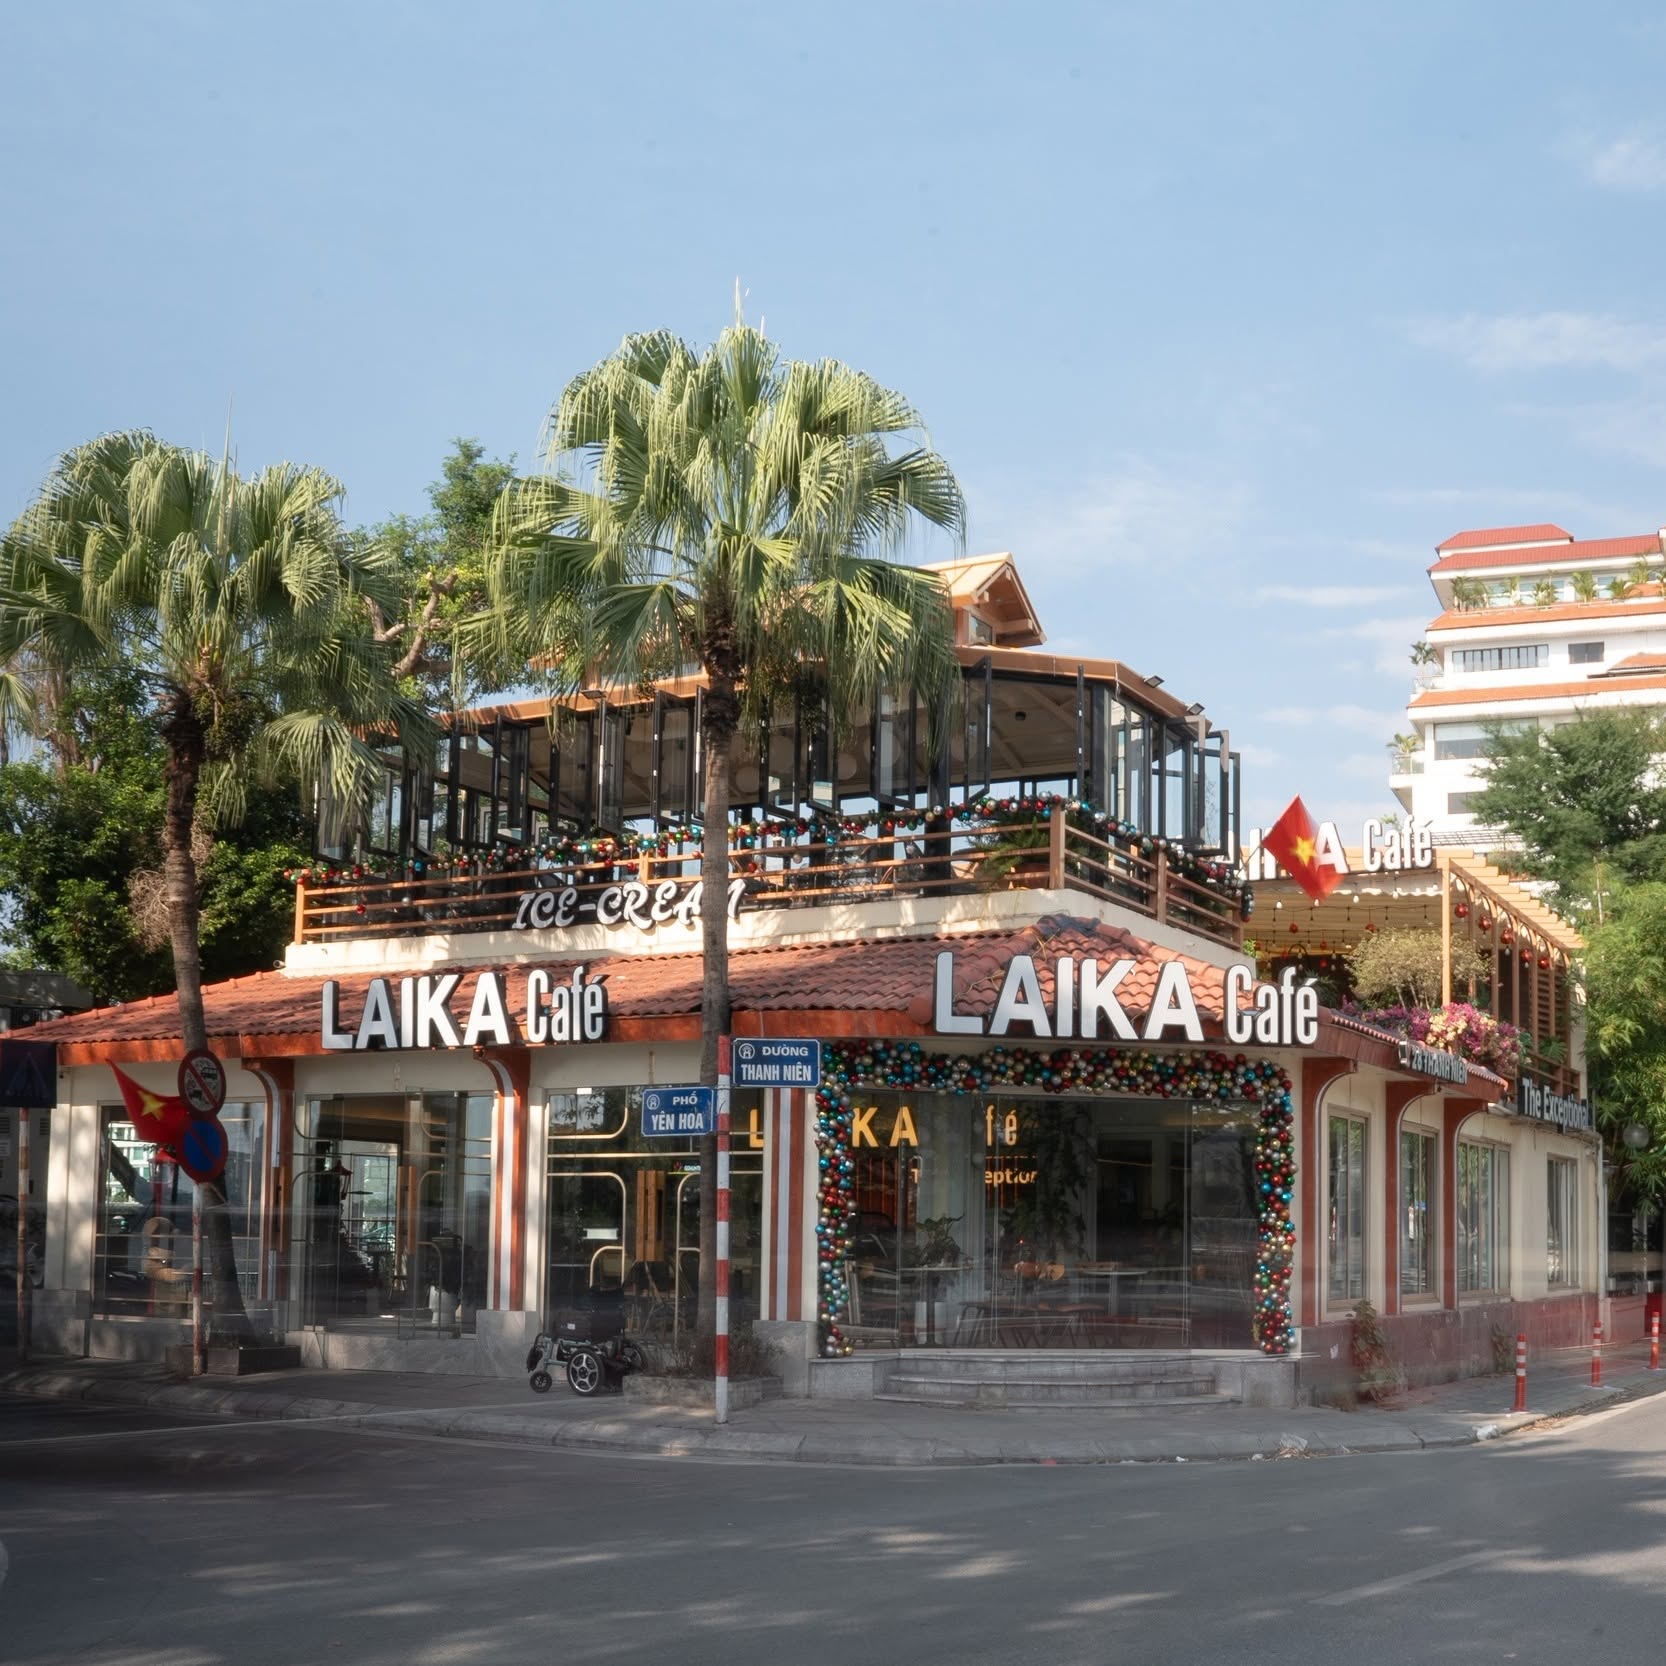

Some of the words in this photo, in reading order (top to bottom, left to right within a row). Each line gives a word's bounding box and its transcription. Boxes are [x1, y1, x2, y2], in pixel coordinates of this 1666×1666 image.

[1362, 813, 1434, 872] Café
[321, 971, 511, 1049] LAIKA
[527, 965, 609, 1043] Café
[936, 950, 1205, 1042] LAIKA
[1225, 963, 1319, 1046] Café
[762, 1043, 809, 1057] ĐƯỜNG
[741, 1063, 780, 1081] THANH
[783, 1061, 812, 1082] NIÊN
[672, 1090, 698, 1106] PHỐ
[1522, 1076, 1542, 1118] The
[1543, 1084, 1589, 1135] Exceptional
[651, 1110, 675, 1131] YÊN
[679, 1112, 704, 1130] HOA
